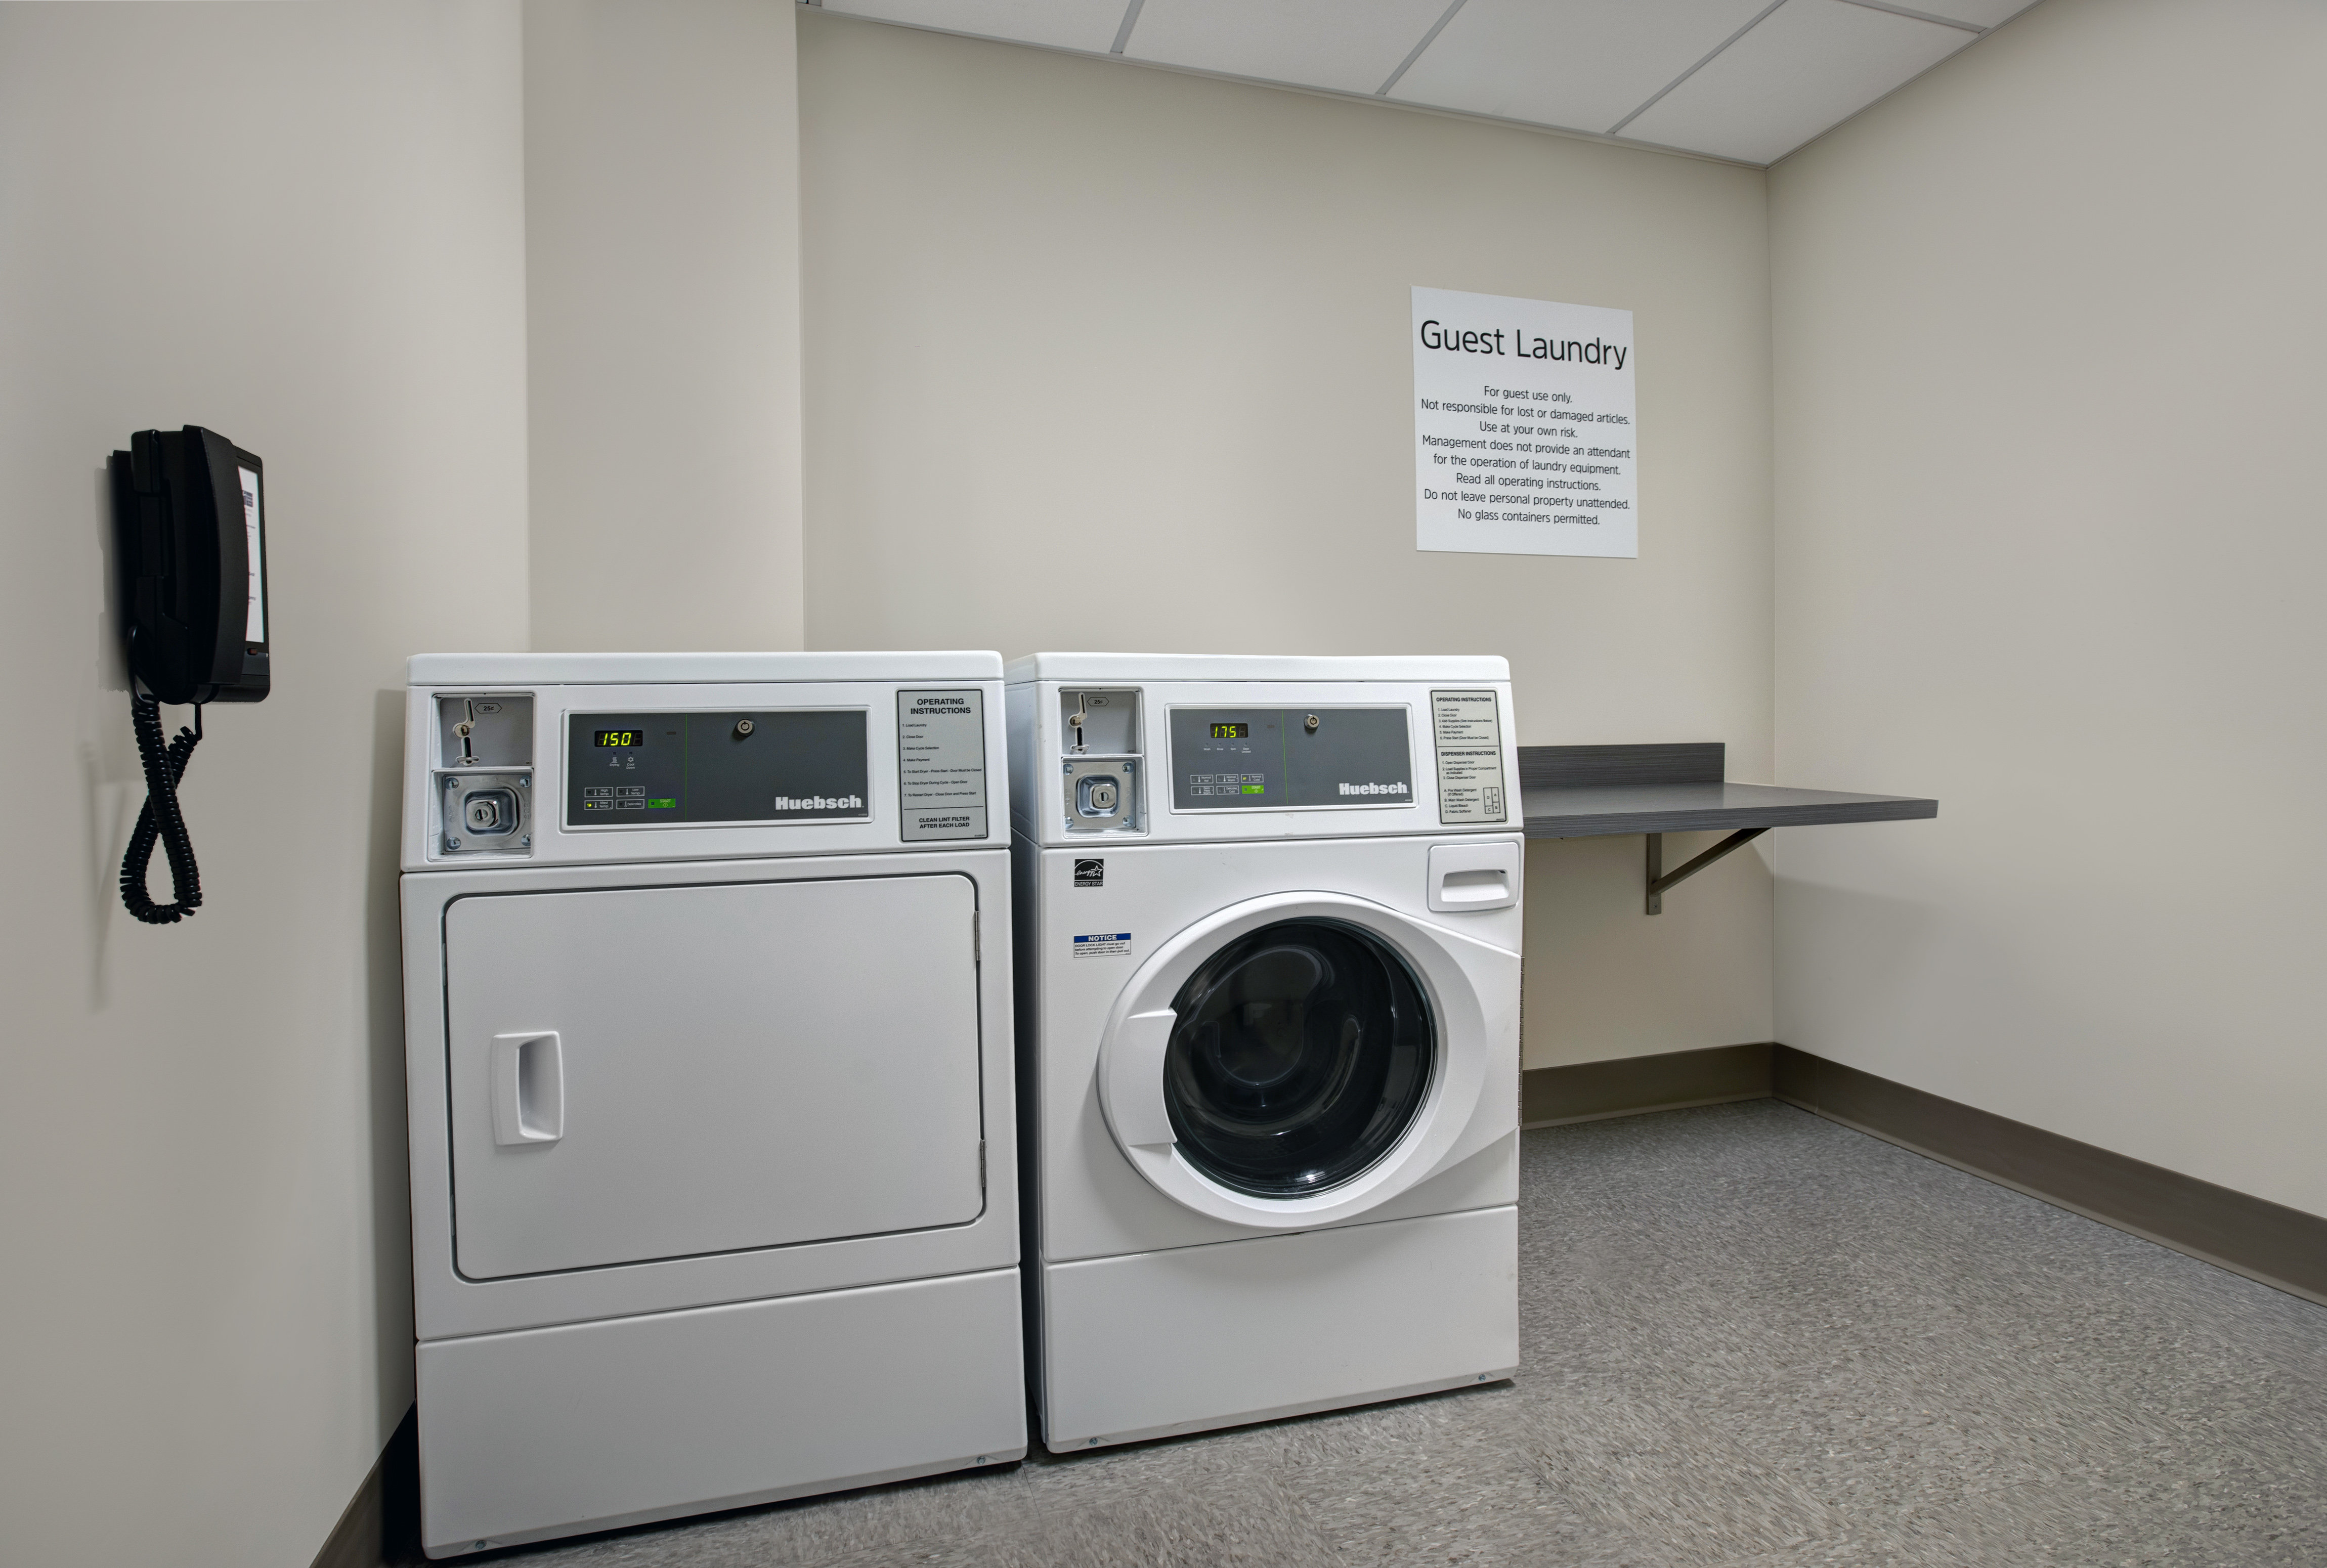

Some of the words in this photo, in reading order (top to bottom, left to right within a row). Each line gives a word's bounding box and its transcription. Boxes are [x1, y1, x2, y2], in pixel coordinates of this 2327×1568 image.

[1421, 320, 1505, 355] Guest
[1517, 329, 1626, 370] Laundry
[1485, 386, 1499, 397] For
[1503, 390, 1529, 399] guest
[1533, 393, 1548, 401] use
[1552, 393, 1572, 404] only.
[1422, 399, 1439, 410] Not
[1443, 403, 1497, 414] responsible
[1501, 405, 1514, 415] for
[1518, 407, 1534, 417] lost
[1550, 409, 1593, 422] damaged
[1597, 414, 1629, 424] articles.
[1480, 421, 1497, 432] Use
[1501, 424, 1510, 432] at
[1514, 426, 1534, 434] your
[1537, 427, 1557, 435] own
[1561, 427, 1577, 437] risk.
[1423, 435, 1486, 449] Management
[1490, 440, 1513, 451] does
[1517, 443, 1532, 452] not
[1536, 445, 1570, 454] provide
[1587, 448, 1630, 458] attendant
[1434, 454, 1447, 464] for
[1451, 455, 1467, 465] the
[1471, 458, 1516, 468] operation
[1520, 459, 1529, 469] of
[1533, 460, 1567, 472] laundry
[1570, 464, 1620, 474] equipment.
[1457, 473, 1480, 484] Read
[1485, 475, 1494, 484] all
[1499, 477, 1543, 489] operating
[1547, 480, 1601, 490] instructions.
[1425, 489, 1438, 499] Do
[1442, 491, 1457, 500] not
[1461, 491, 1485, 502] leave
[1490, 495, 1529, 504] personal
[1534, 497, 1573, 507] property
[1577, 499, 1629, 509] unattended.
[1458, 509, 1471, 519] No
[1475, 510, 1498, 521] glass
[1502, 512, 1550, 522] containers
[1554, 514, 1600, 525] permitted.
[604, 732, 631, 746] 150
[1215, 726, 1236, 737] 175
[1339, 781, 1408, 795] Huebsch
[775, 795, 862, 810] Huebsch
